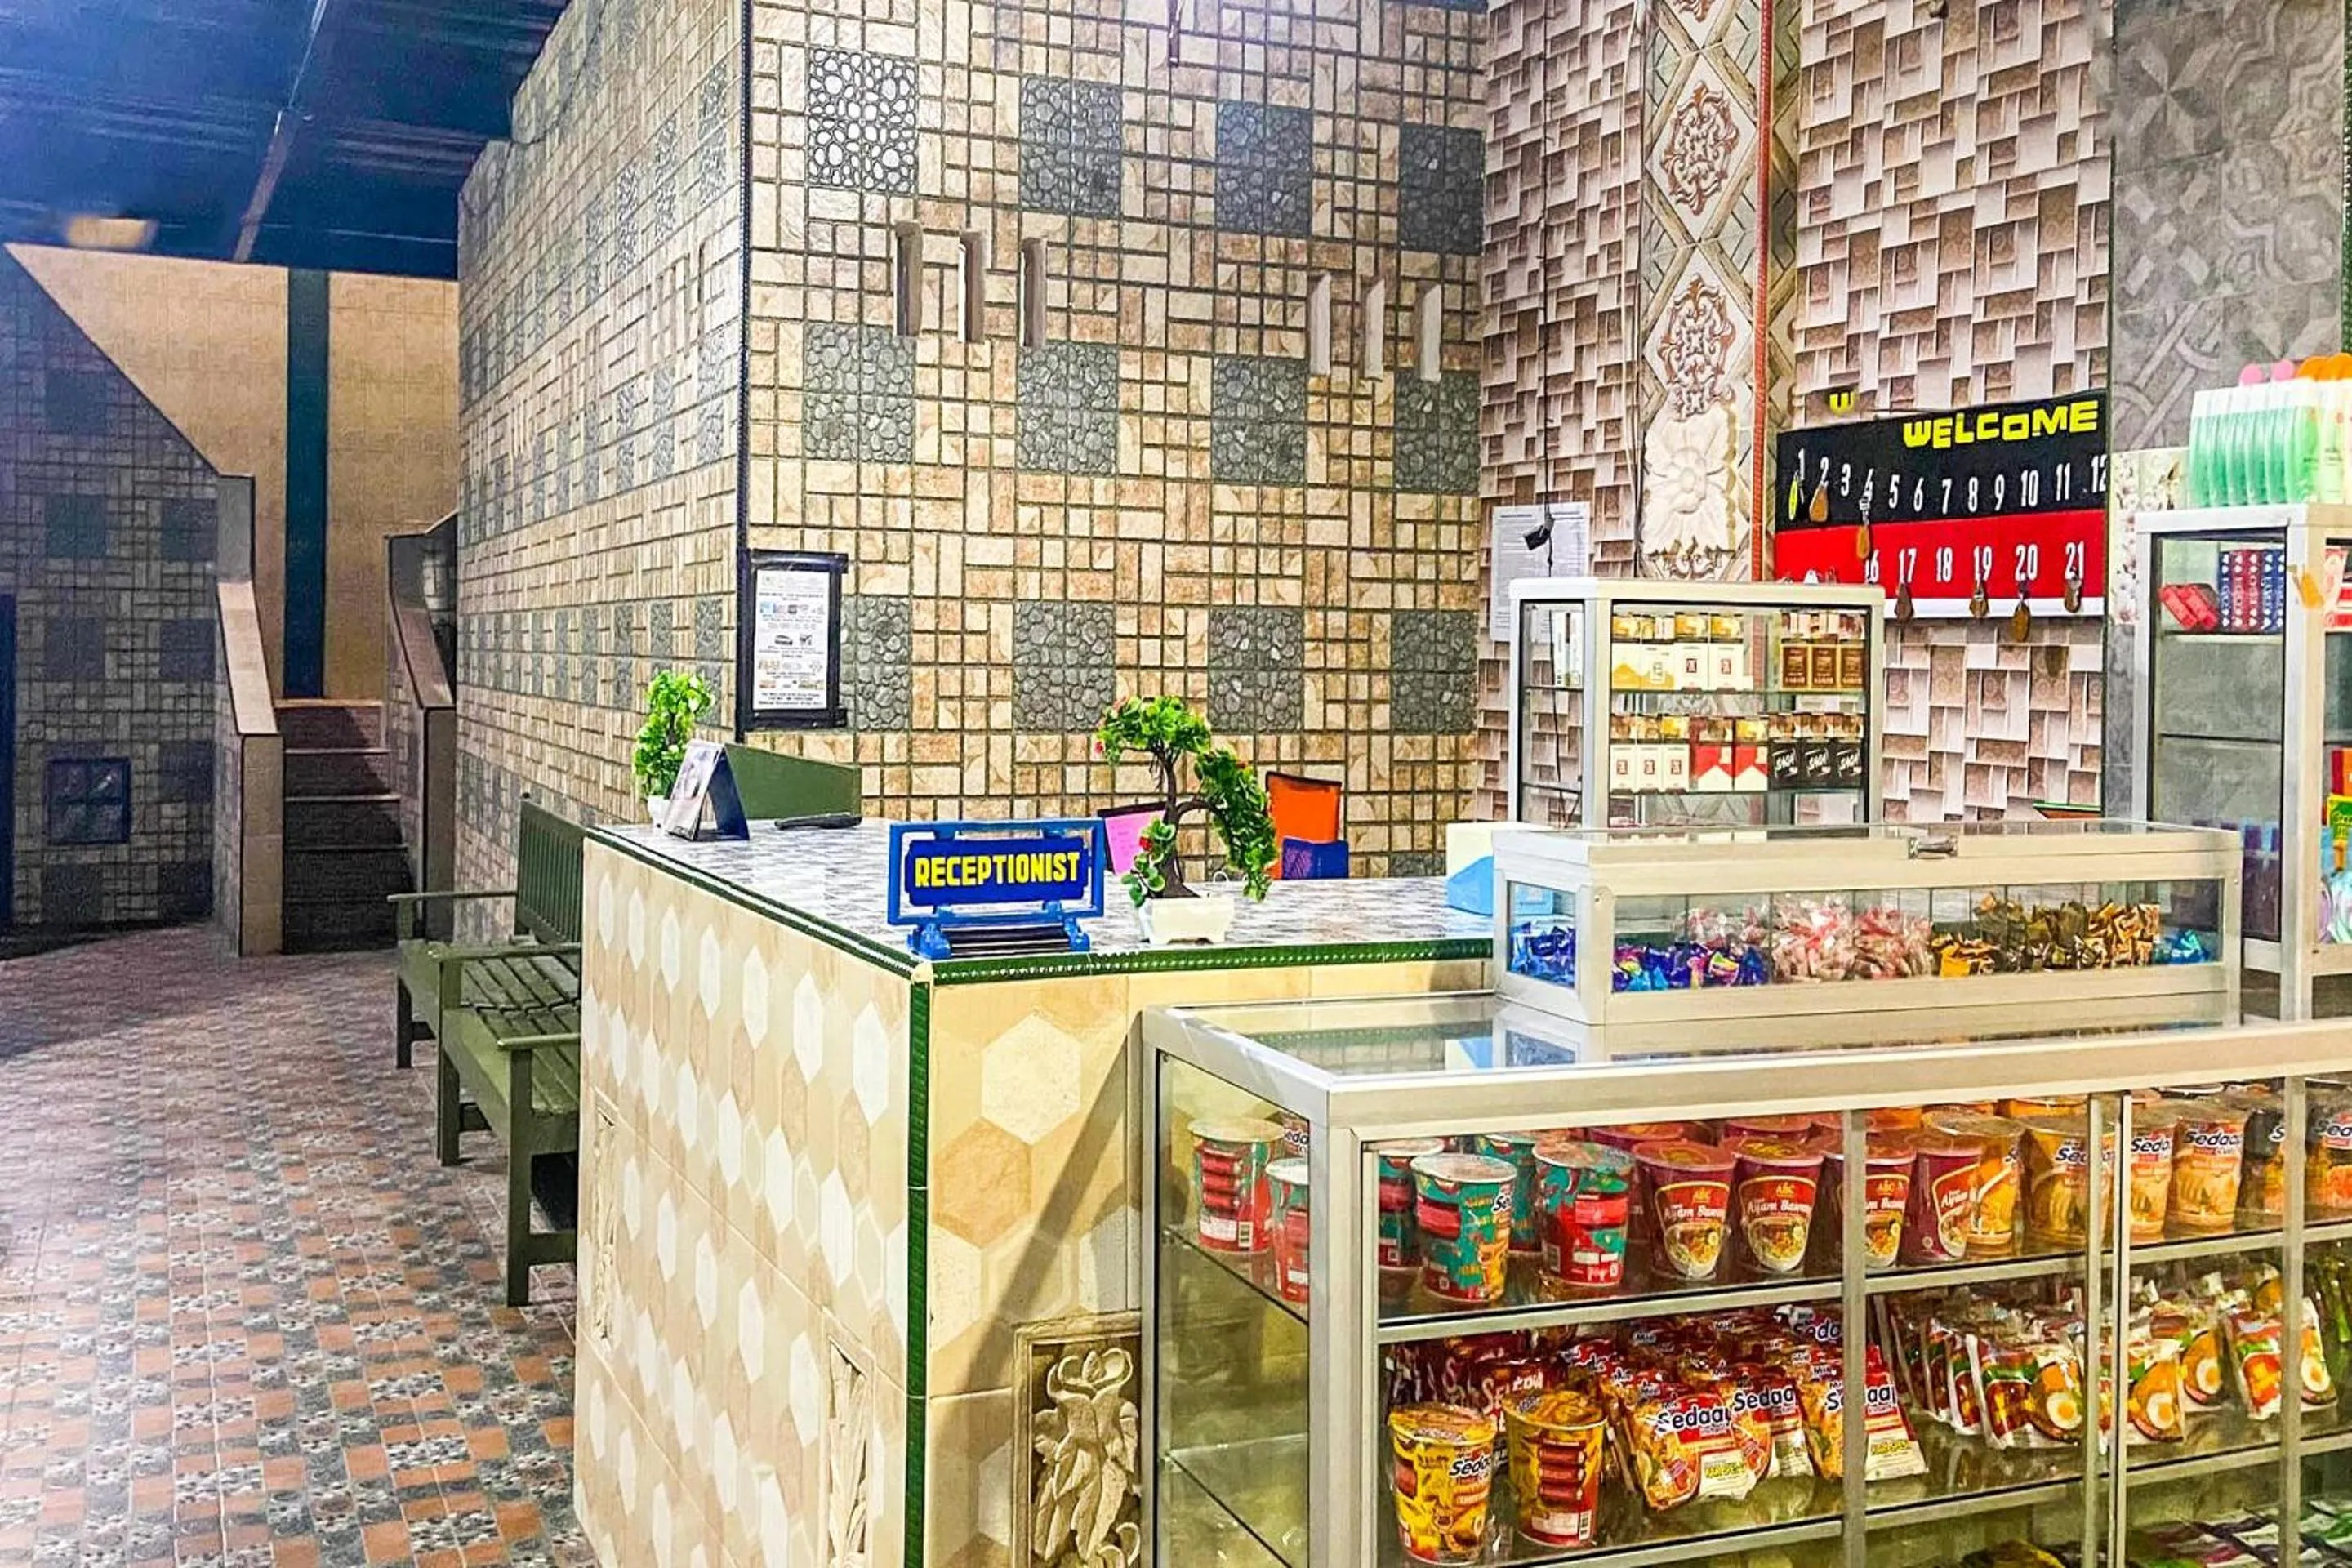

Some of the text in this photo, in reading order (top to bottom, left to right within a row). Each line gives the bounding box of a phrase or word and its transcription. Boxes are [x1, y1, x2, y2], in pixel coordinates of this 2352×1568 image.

[1903, 400, 2098, 449] WELCOME
[1799, 448, 1805, 480] 1
[1820, 456, 1829, 487] 2
[1841, 463, 1851, 497] 3
[1888, 474, 1900, 509] 5
[1913, 477, 1924, 512] 6
[1941, 478, 1953, 514] 7
[1967, 476, 1979, 513] 8
[1994, 474, 2006, 512] 9
[2020, 470, 2039, 508] 10
[2056, 462, 2071, 501] 11
[2091, 453, 2107, 493] 12
[1898, 547, 1917, 584] 17
[1936, 546, 1953, 582] 18
[1973, 546, 1993, 581] 19
[2015, 543, 2038, 581] 20
[2065, 540, 2084, 580] 21
[915, 852, 1080, 888] RECEPTIONIST
